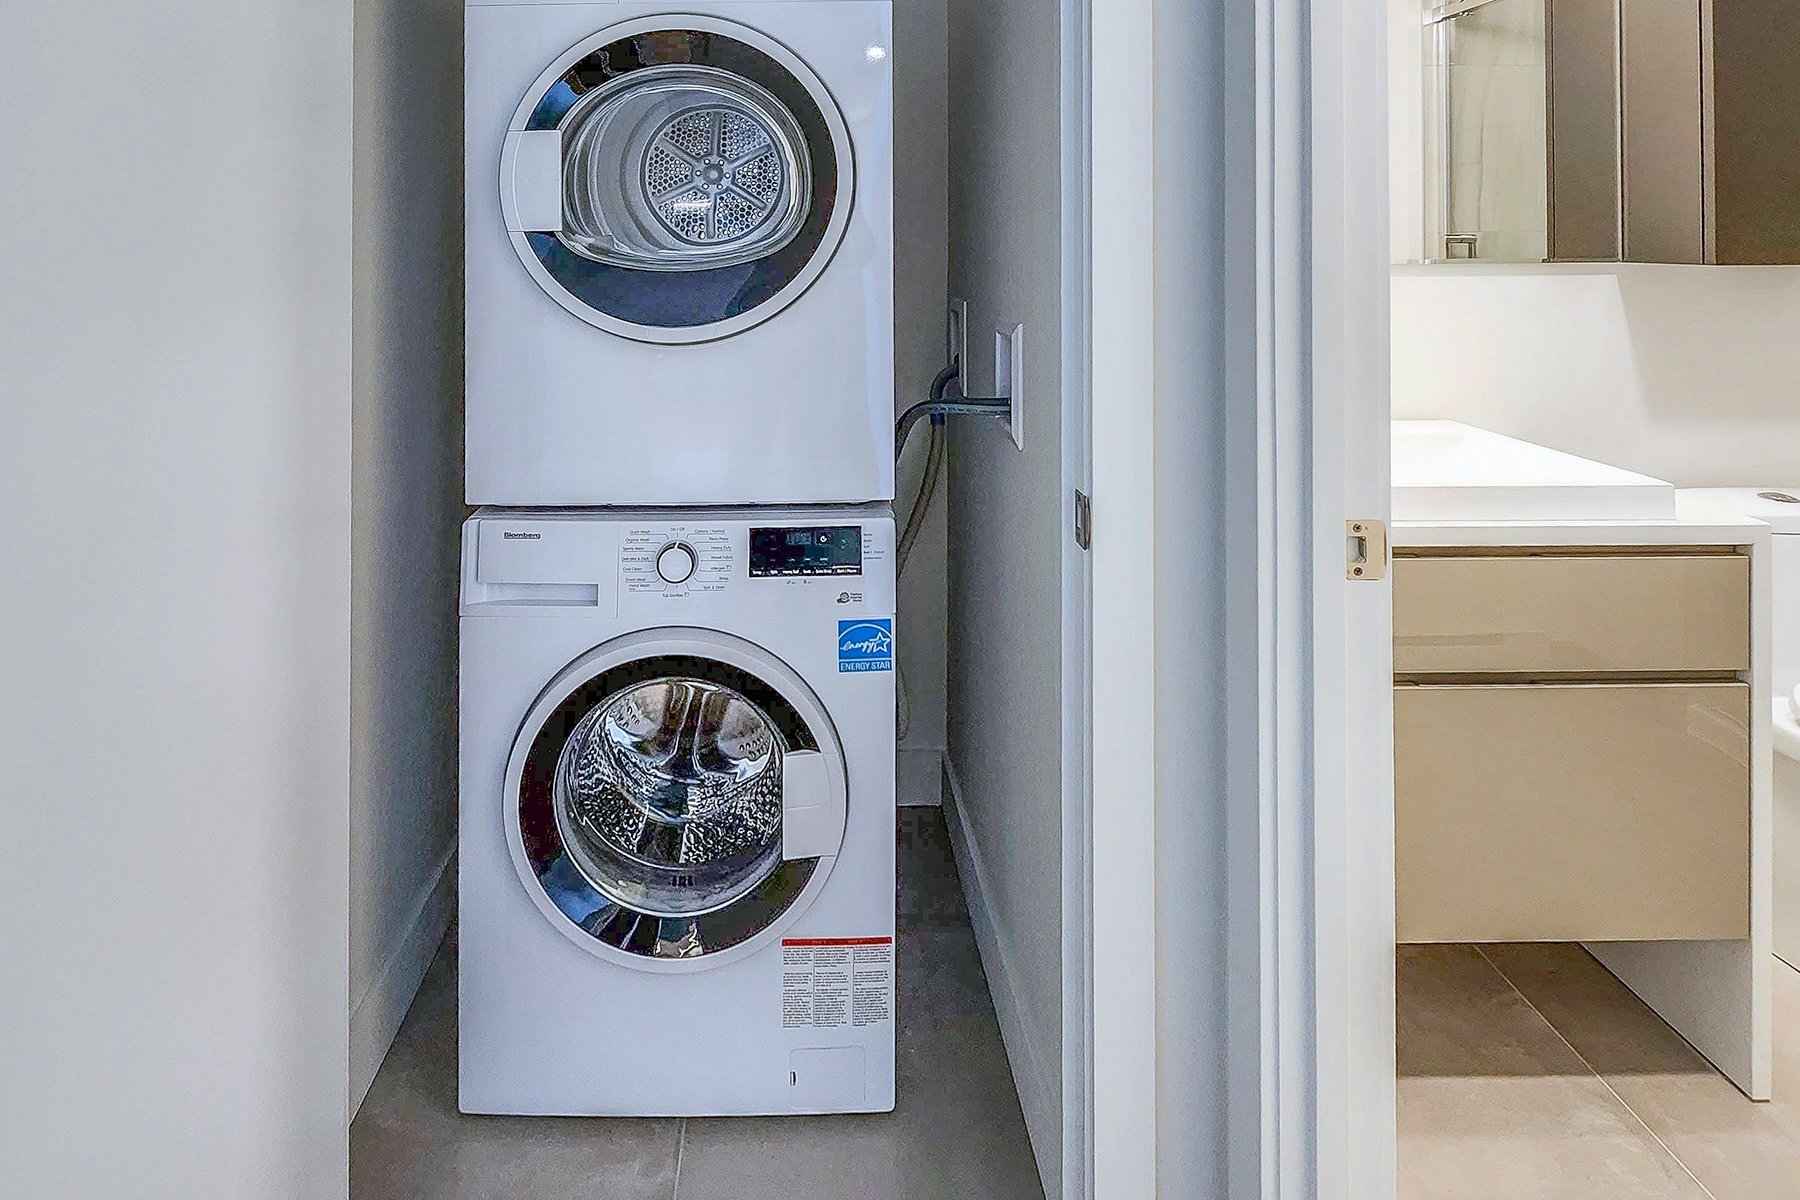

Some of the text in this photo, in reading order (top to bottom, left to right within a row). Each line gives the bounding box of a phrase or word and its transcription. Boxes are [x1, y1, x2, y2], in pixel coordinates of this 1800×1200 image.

[503, 531, 541, 540] Blomberg
[840, 661, 891, 671] ENERGY STAR
